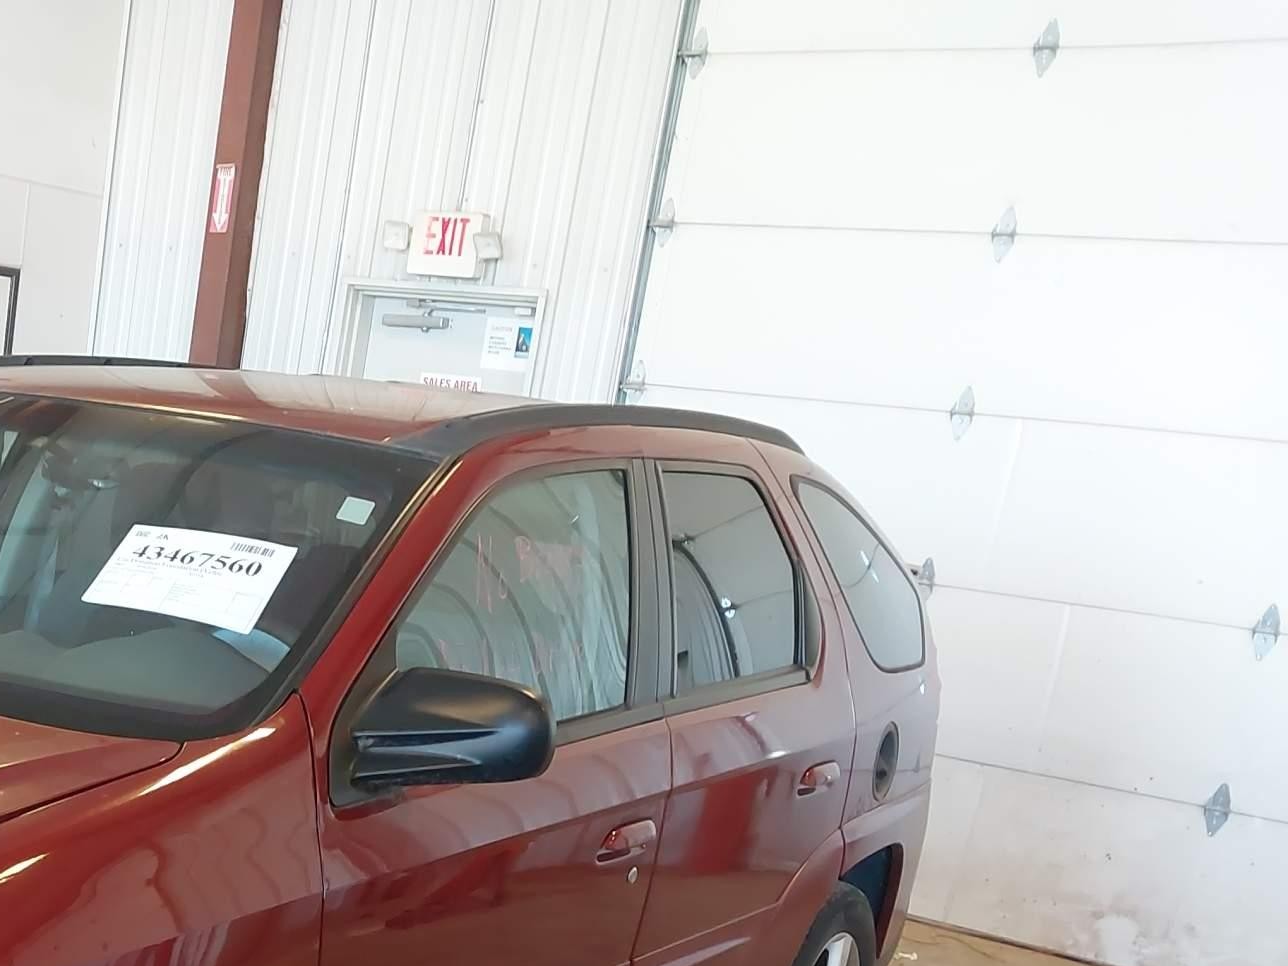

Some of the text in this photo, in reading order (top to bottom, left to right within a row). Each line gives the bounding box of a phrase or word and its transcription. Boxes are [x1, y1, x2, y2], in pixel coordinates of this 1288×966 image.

[423, 216, 471, 257] EXIT
[423, 376, 479, 393] SALES AREA
[131, 543, 263, 578] 43467560
